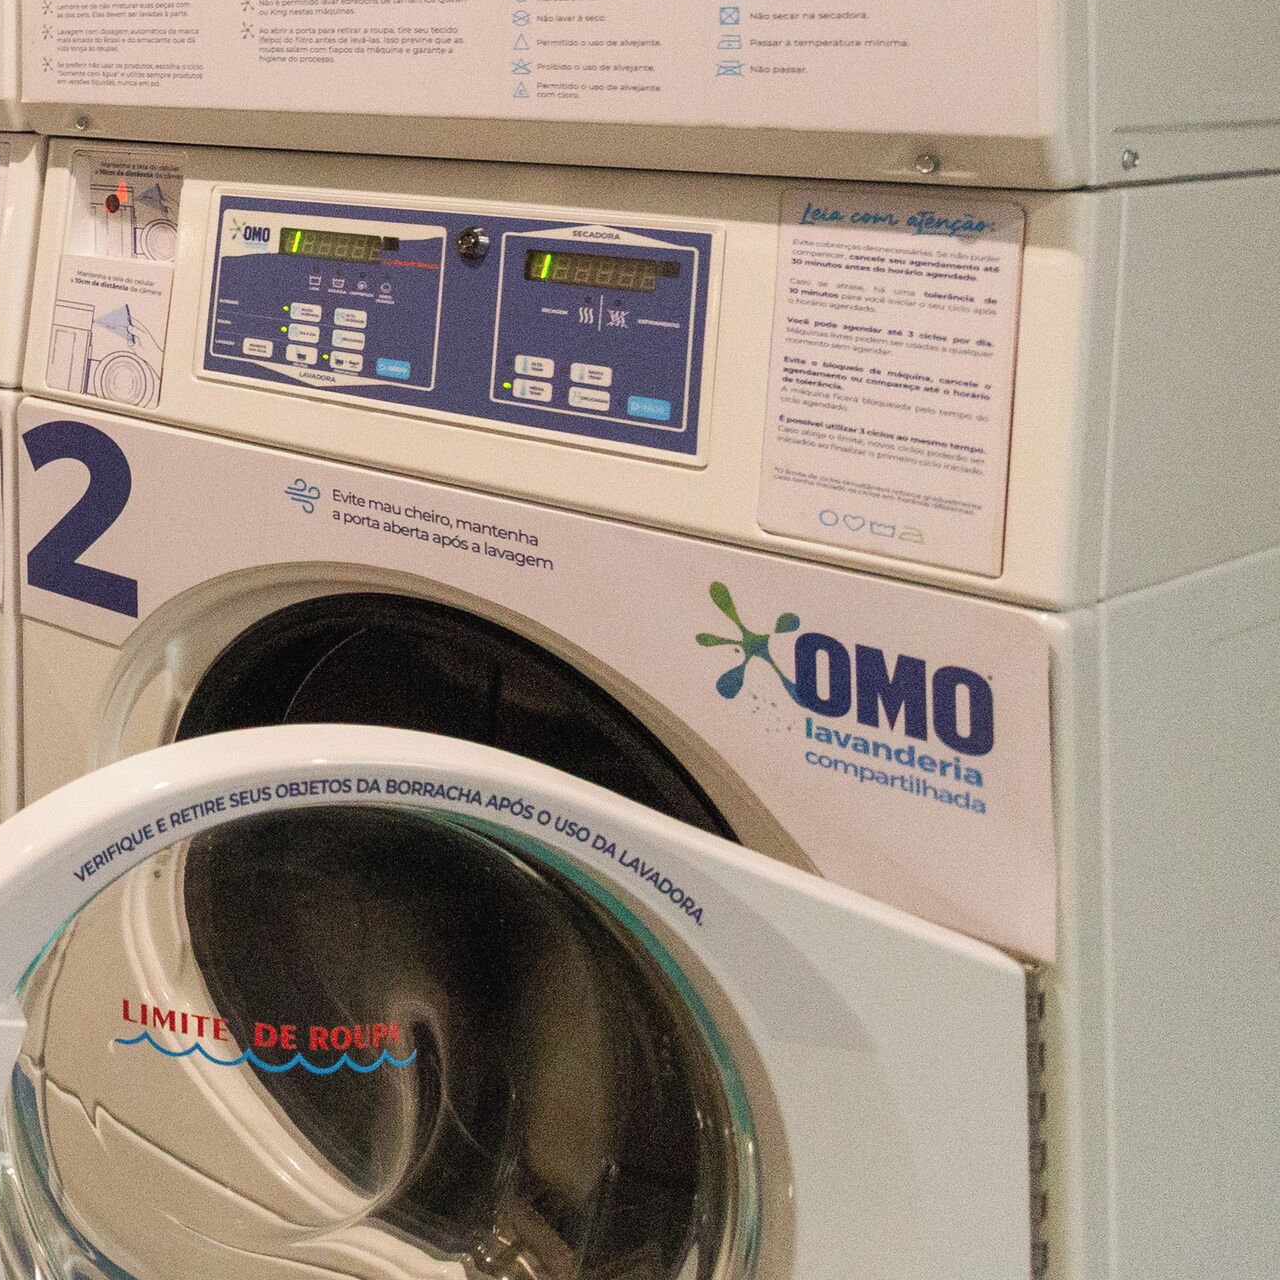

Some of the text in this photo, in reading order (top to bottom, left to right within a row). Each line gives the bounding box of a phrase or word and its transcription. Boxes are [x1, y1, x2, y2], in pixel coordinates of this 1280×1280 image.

[243, 225, 271, 243] OMO
[572, 230, 621, 240] SECADORA
[799, 202, 843, 225] Leia
[851, 209, 898, 226] com
[299, 371, 337, 383] LAVADORA
[21, 420, 139, 619] 2
[332, 510, 553, 569] a porta aberta após a lavagem
[333, 489, 538, 546] Evite mau cheiro, mantenha
[794, 632, 994, 757] OMO
[805, 717, 985, 788] lavanderia
[805, 750, 986, 814] compartilhada
[73, 825, 155, 882] VERIFIQUE
[157, 821, 167, 834] E
[170, 796, 226, 828] RETIRE
[229, 785, 272, 808] SEUS
[275, 778, 352, 798] OBJETOS
[356, 778, 380, 794] DA
[386, 779, 482, 806] BORRACHA
[486, 794, 535, 820] APÓS
[537, 809, 551, 826] O
[554, 816, 590, 843] USO
[591, 834, 616, 859] DA
[122, 998, 401, 1051] LIMITE DE ROUPA
